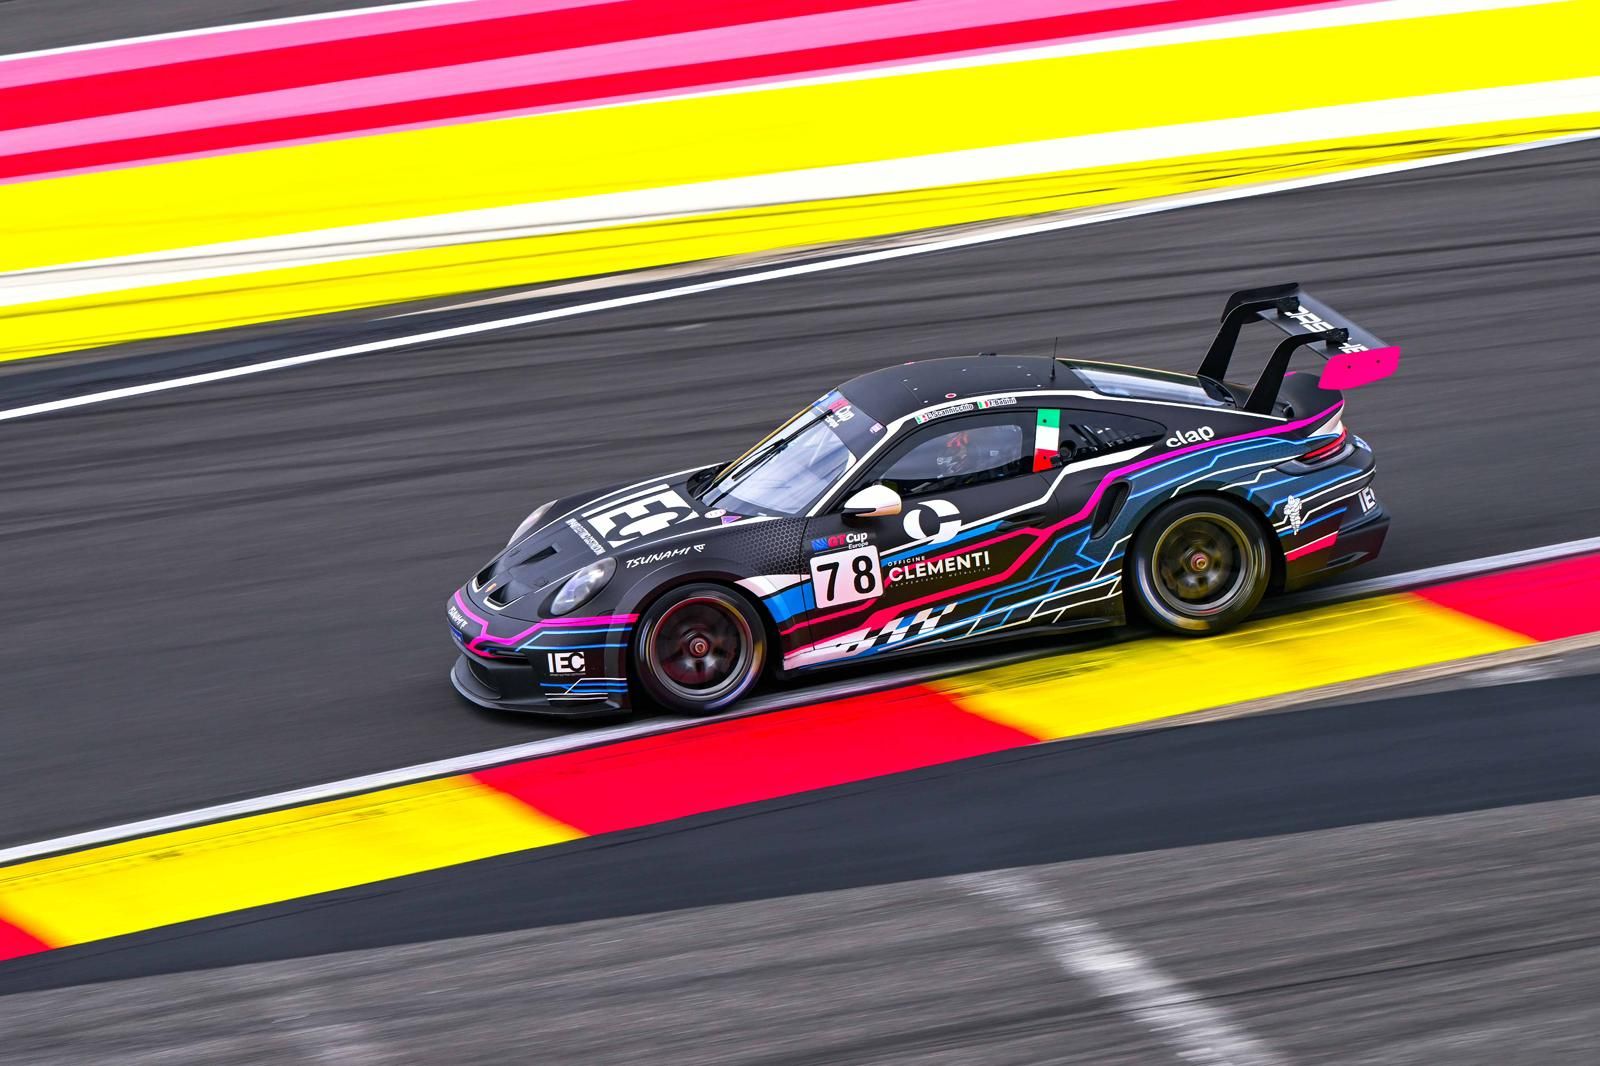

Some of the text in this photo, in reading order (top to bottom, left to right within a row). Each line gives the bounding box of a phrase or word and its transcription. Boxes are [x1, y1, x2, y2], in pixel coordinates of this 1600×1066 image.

[1166, 426, 1215, 447] clap
[846, 532, 868, 543] Cup
[626, 547, 691, 568] TSUNAMI
[887, 556, 926, 567] OFFICINE
[889, 550, 990, 582] CLEMENTI
[816, 555, 876, 601] 78
[547, 652, 586, 673] IEC
